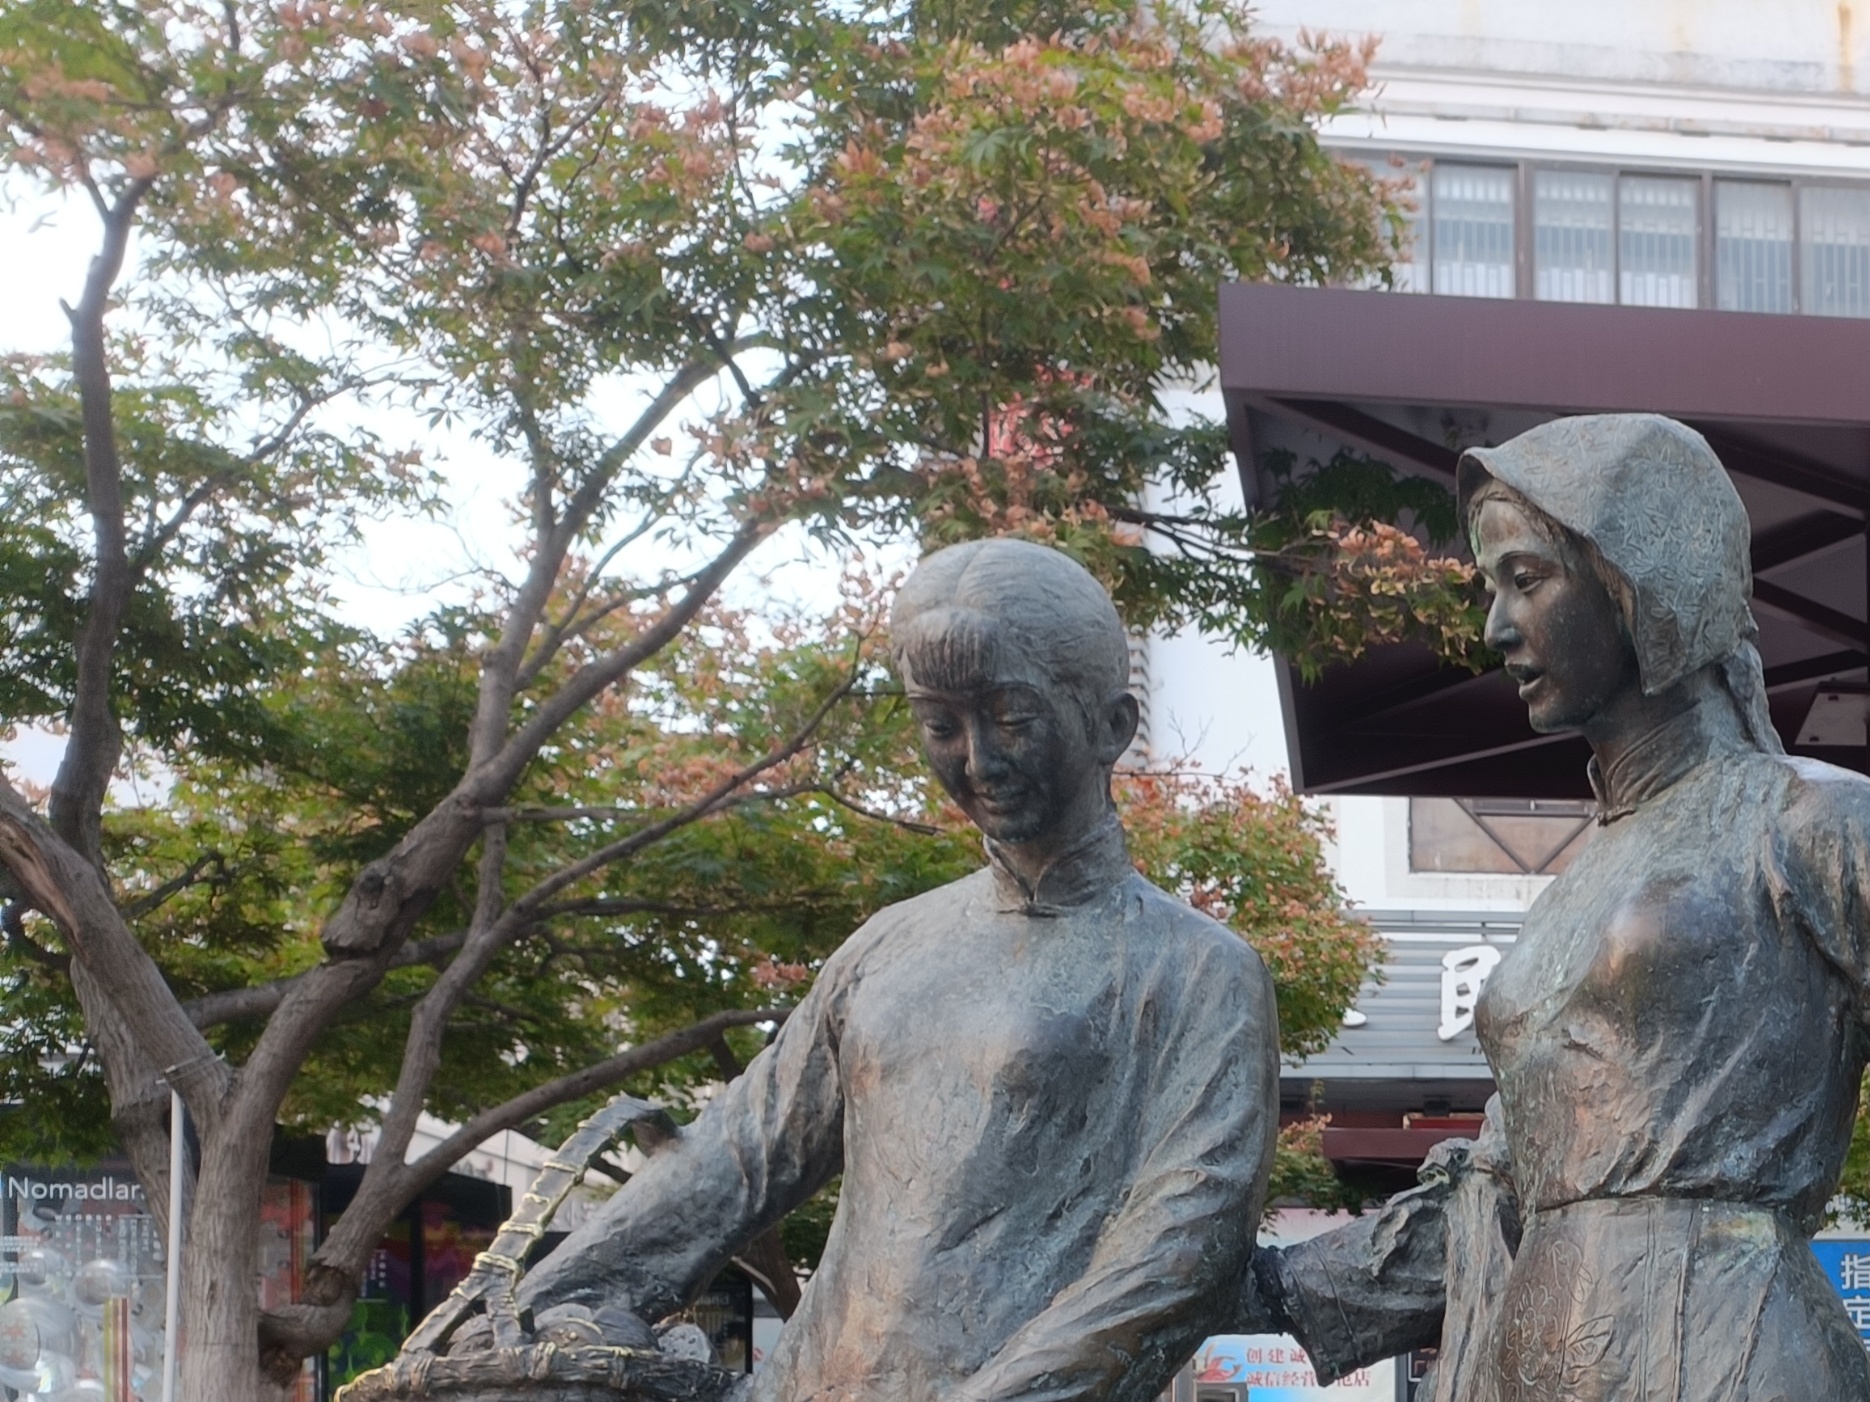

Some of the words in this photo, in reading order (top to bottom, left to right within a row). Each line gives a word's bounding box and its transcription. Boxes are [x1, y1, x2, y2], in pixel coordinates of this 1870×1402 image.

[1246, 1370, 1371, 1388] 诚信经营范店
